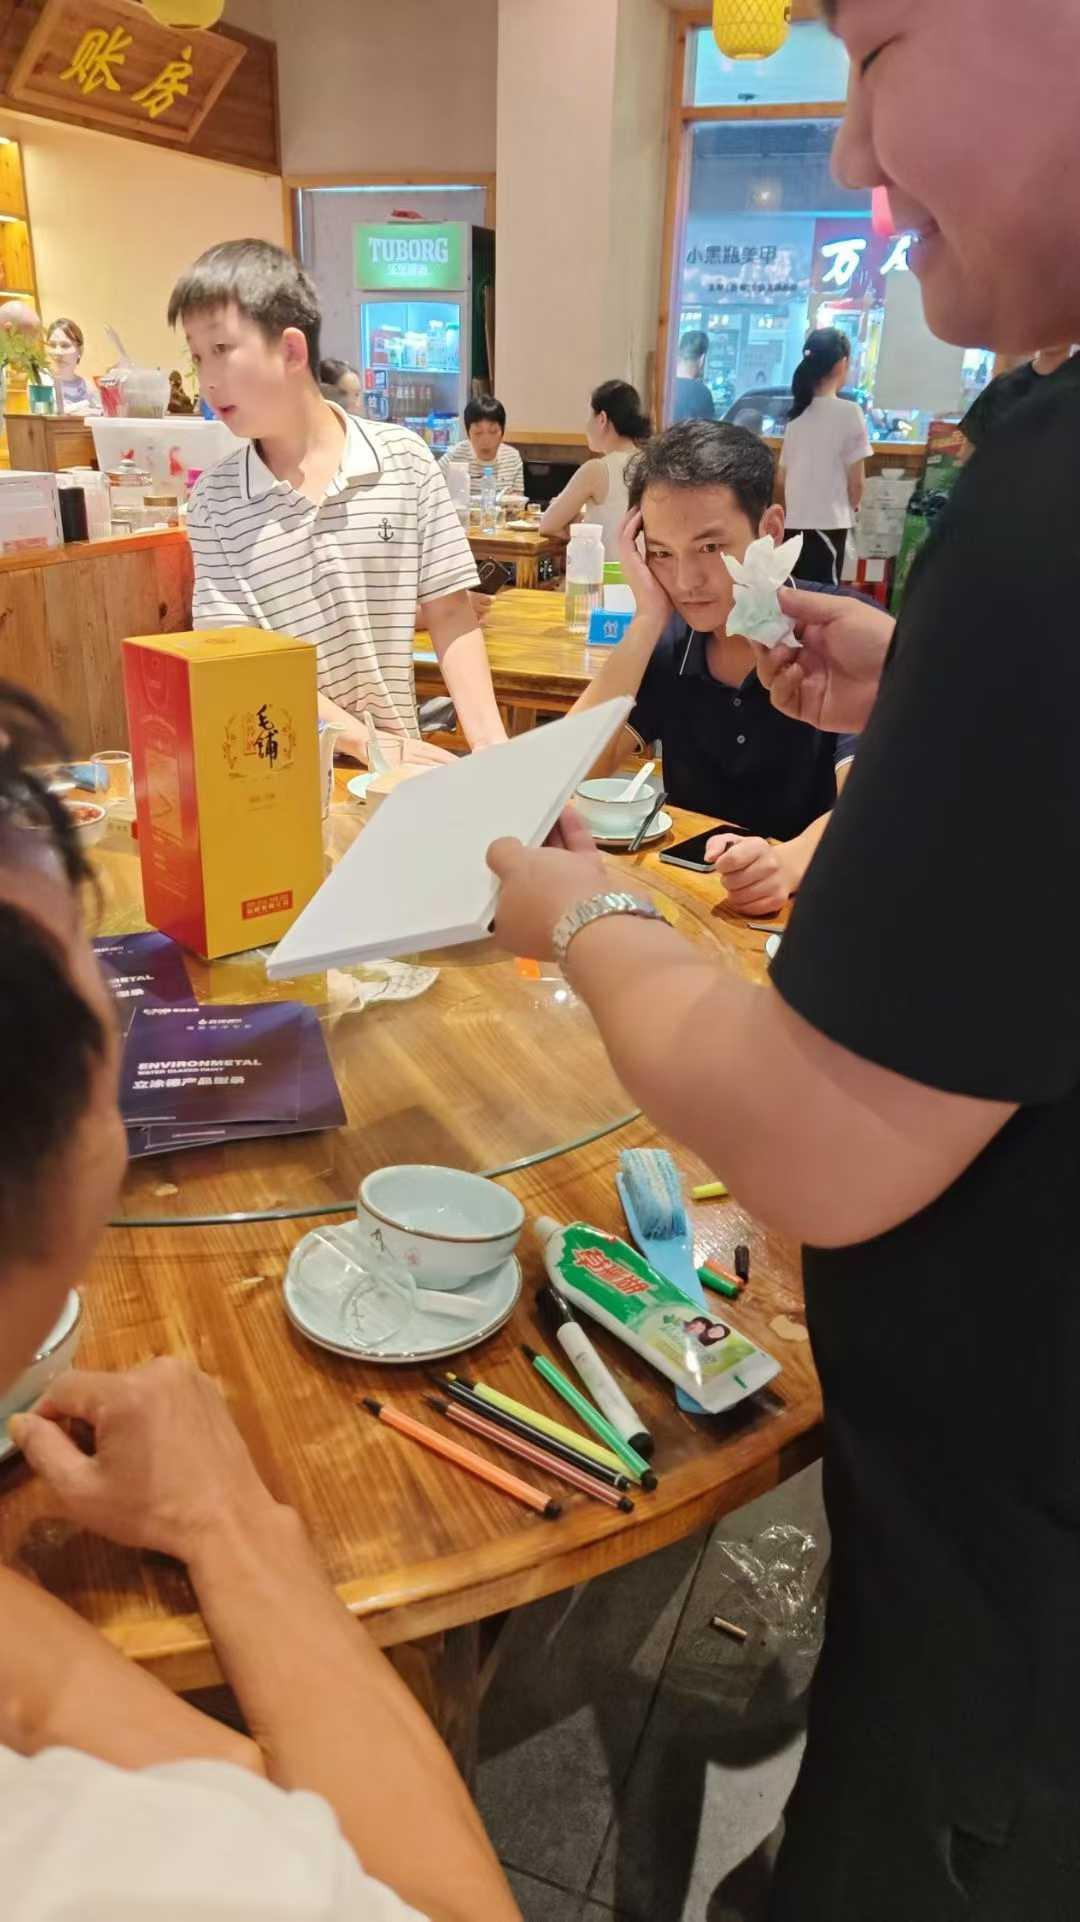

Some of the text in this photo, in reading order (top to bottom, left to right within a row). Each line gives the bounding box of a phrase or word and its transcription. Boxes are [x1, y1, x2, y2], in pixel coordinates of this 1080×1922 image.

[59, 25, 193, 118] 账房
[368, 237, 449, 263] TUBORG
[138, 1059, 262, 1070] ENVIRONMETAL
